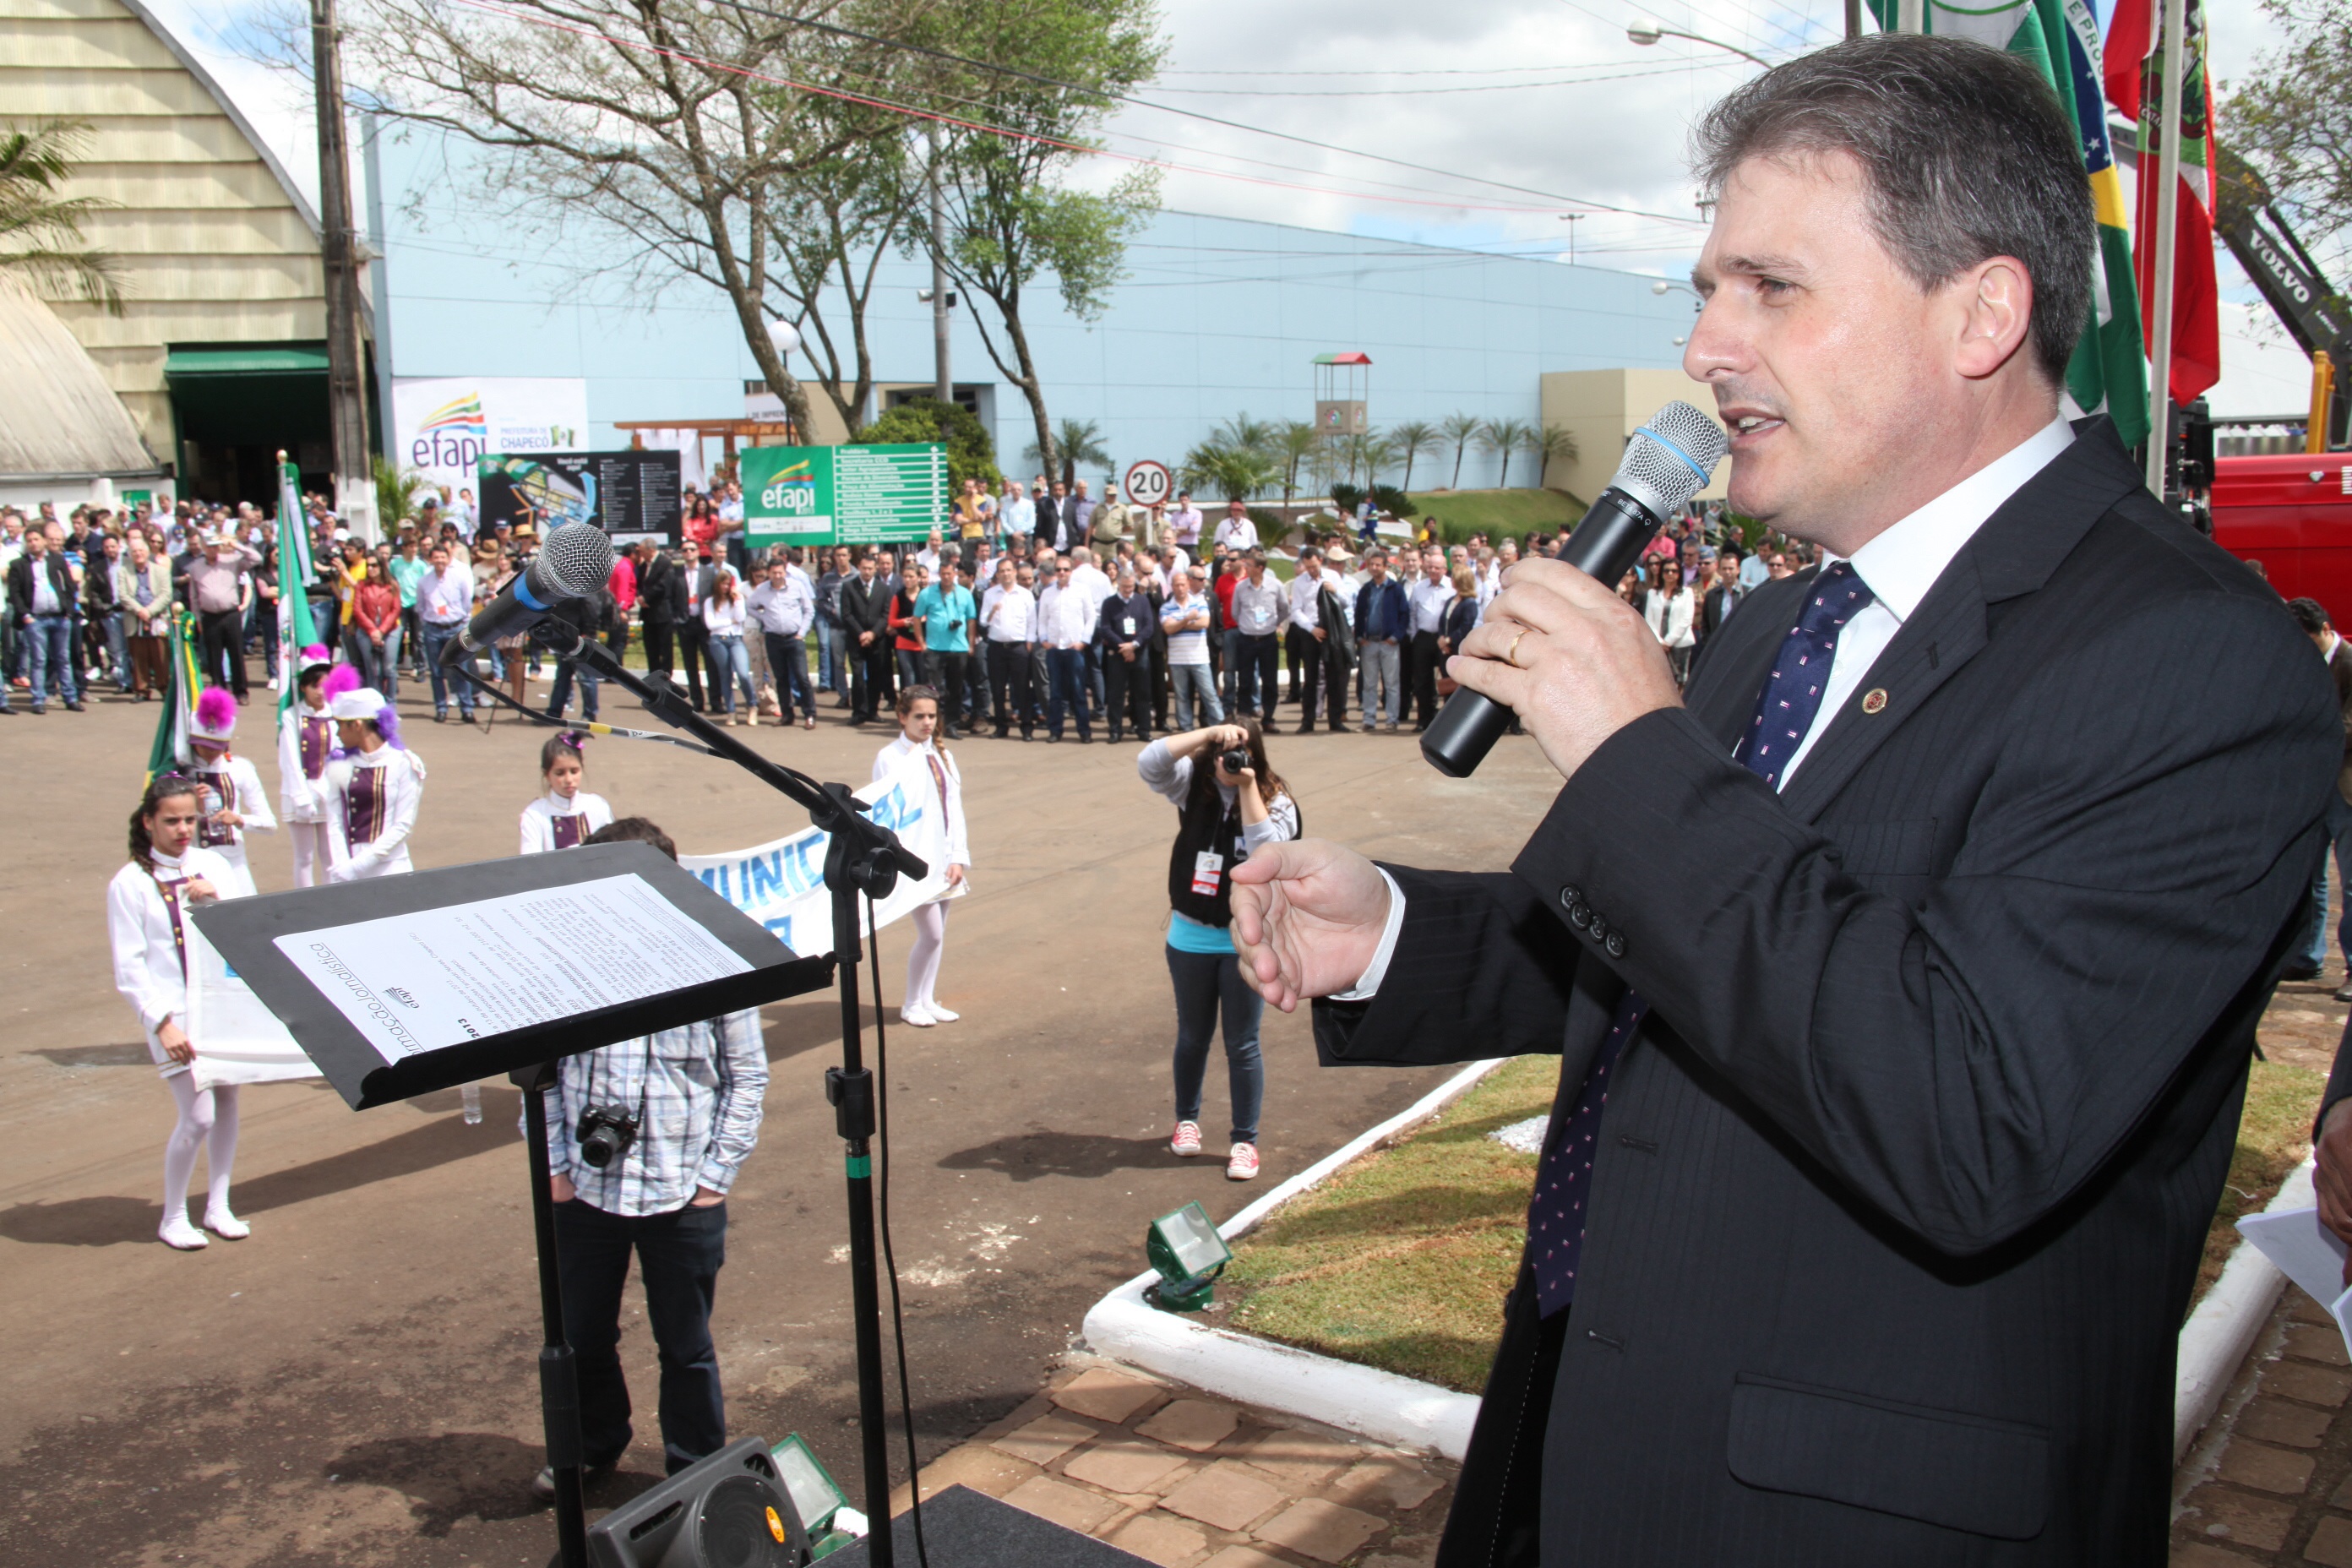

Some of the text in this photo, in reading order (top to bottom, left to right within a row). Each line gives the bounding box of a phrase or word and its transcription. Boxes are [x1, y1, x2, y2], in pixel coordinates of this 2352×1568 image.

[2068, 1, 2083, 15] E
[2250, 229, 2310, 303] VOLVO
[500, 436, 549, 449] CHAPECÓ
[1133, 471, 1164, 493] 20
[761, 483, 815, 515] efapi
[1617, 498, 1644, 520] BETA 87A
[686, 782, 923, 912] MUNICAL
[410, 932, 421, 941] (SC)
[519, 984, 540, 1003] pessoas
[457, 1017, 481, 1038] 2013
